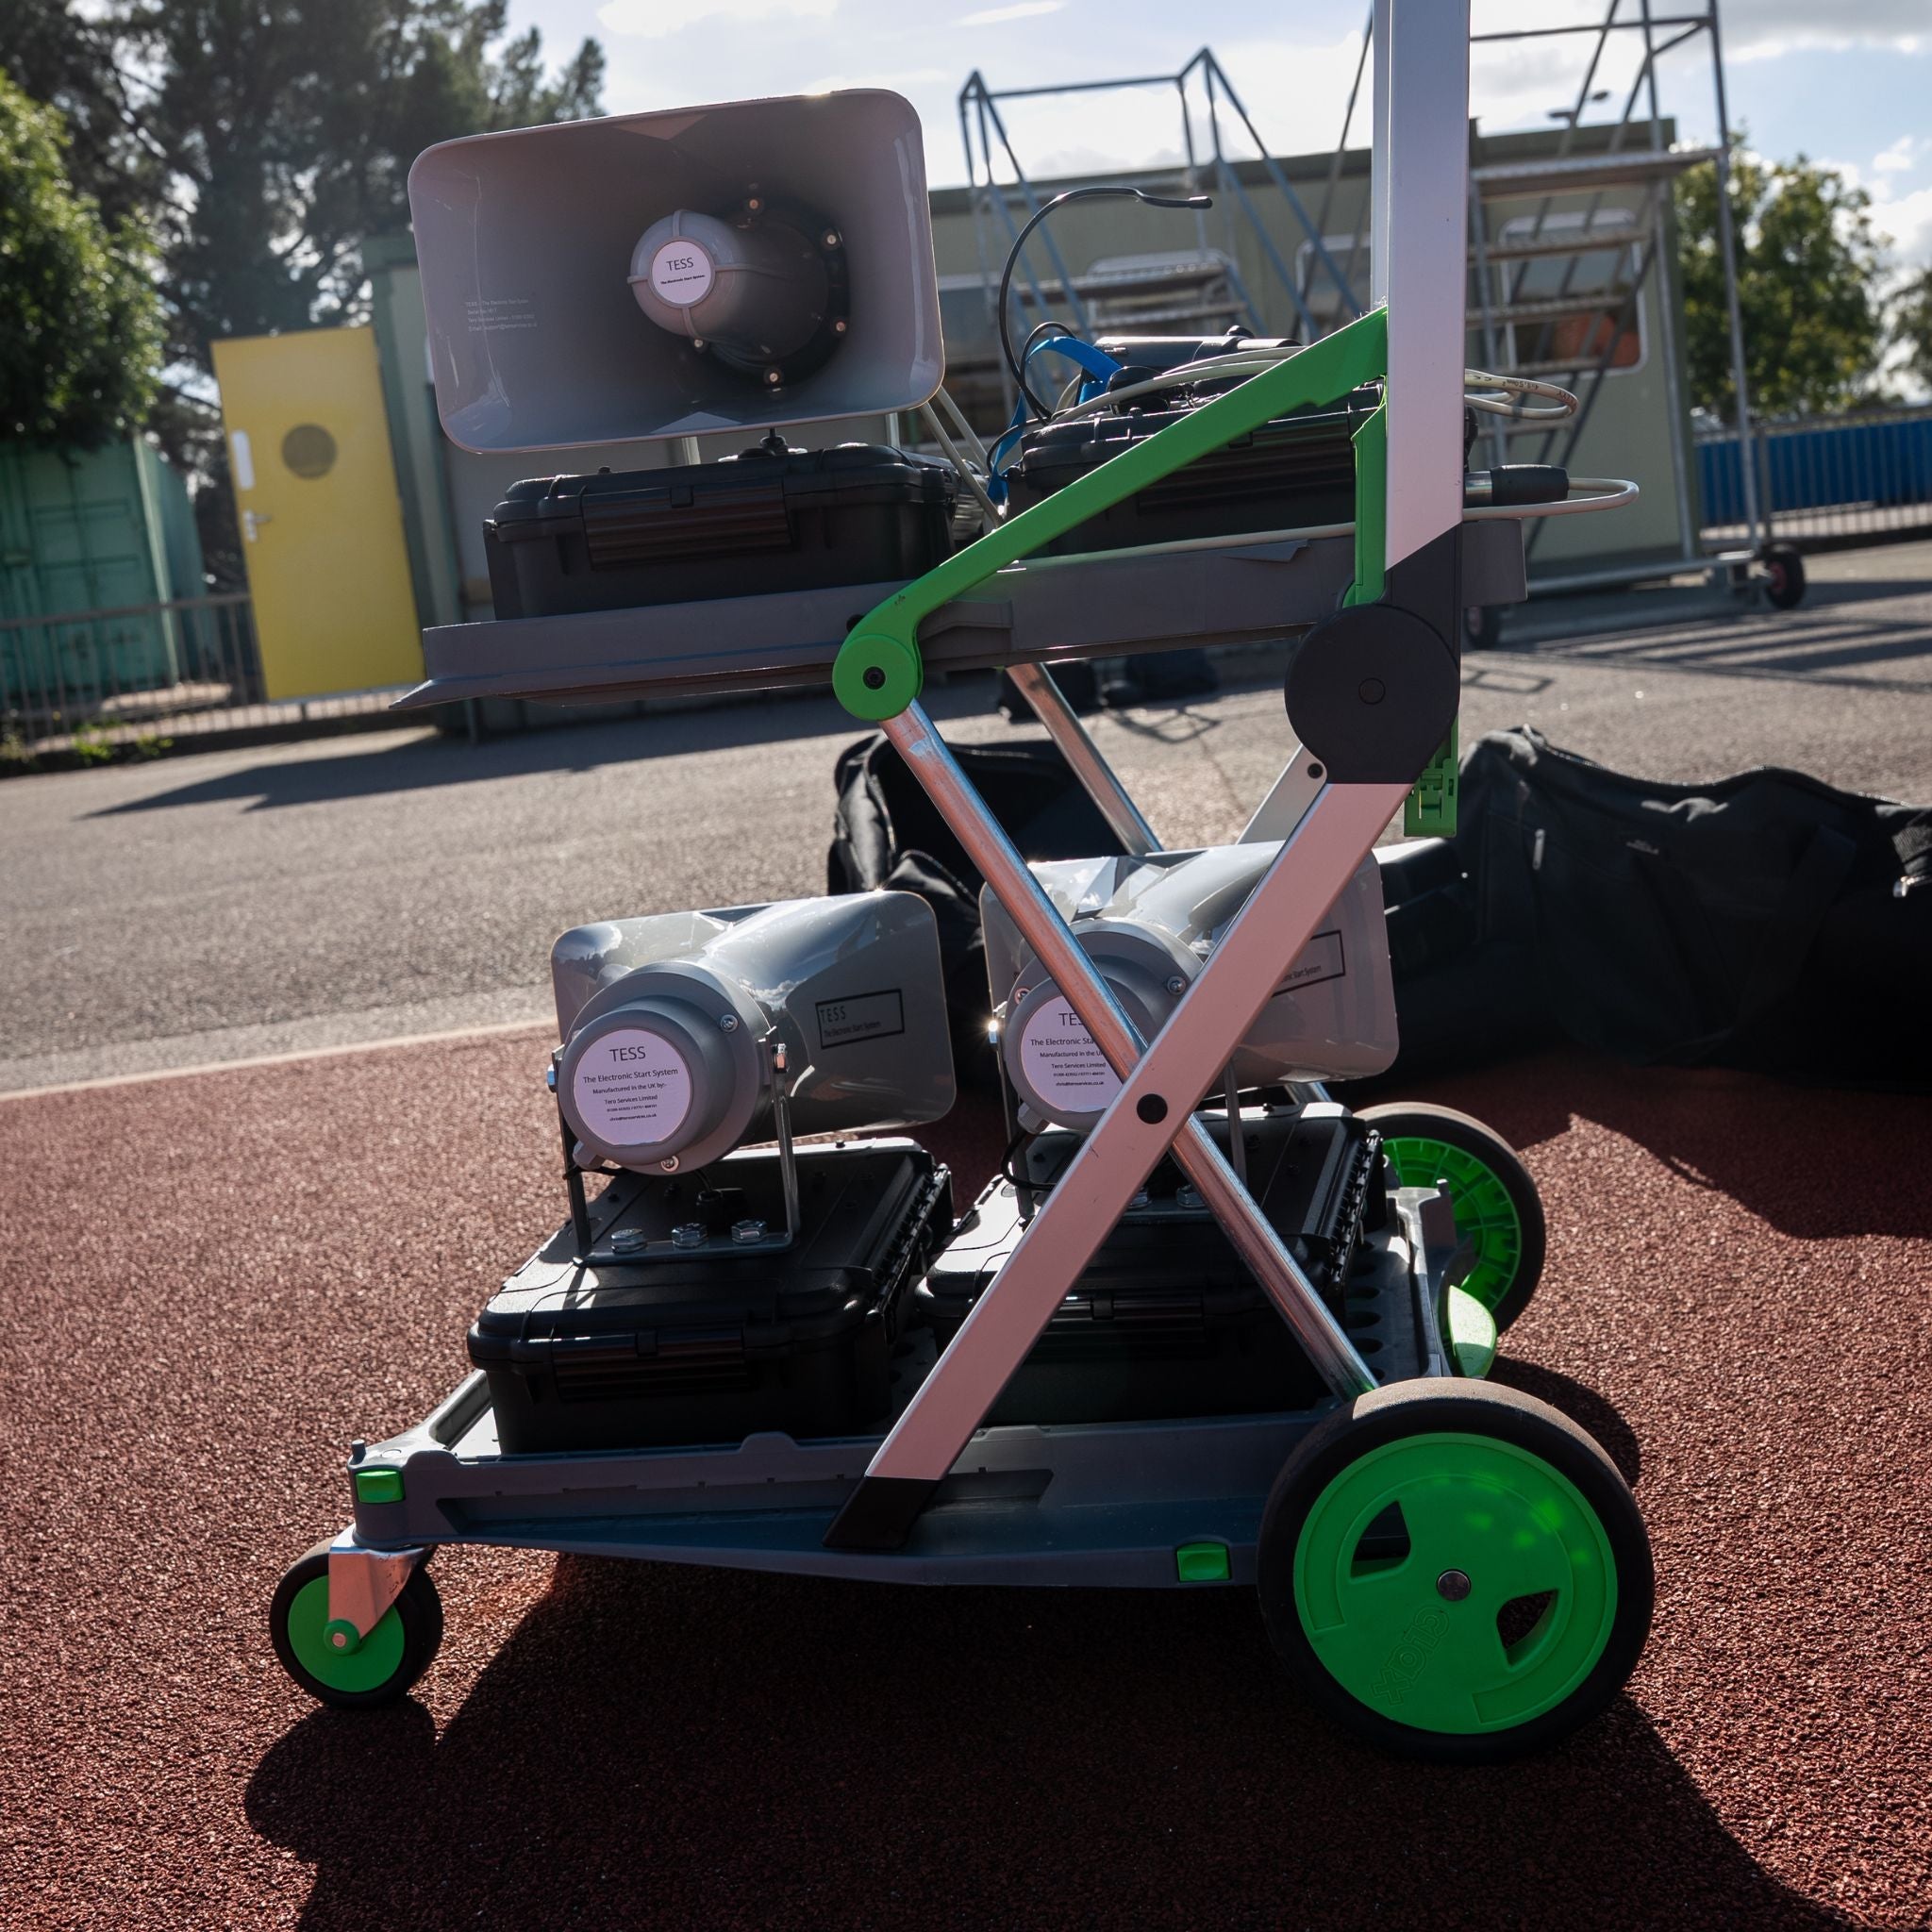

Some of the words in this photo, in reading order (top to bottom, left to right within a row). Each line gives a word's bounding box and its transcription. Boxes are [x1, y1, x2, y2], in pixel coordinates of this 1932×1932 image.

[666, 257, 694, 272] TESS
[819, 1005, 846, 1024] TESS
[609, 1045, 647, 1062] TESS
[583, 1075, 596, 1084] The
[598, 1073, 633, 1083] Electronic
[634, 1070, 651, 1079] Start
[652, 1068, 678, 1078] System
[592, 1086, 631, 1094] Manufactured
